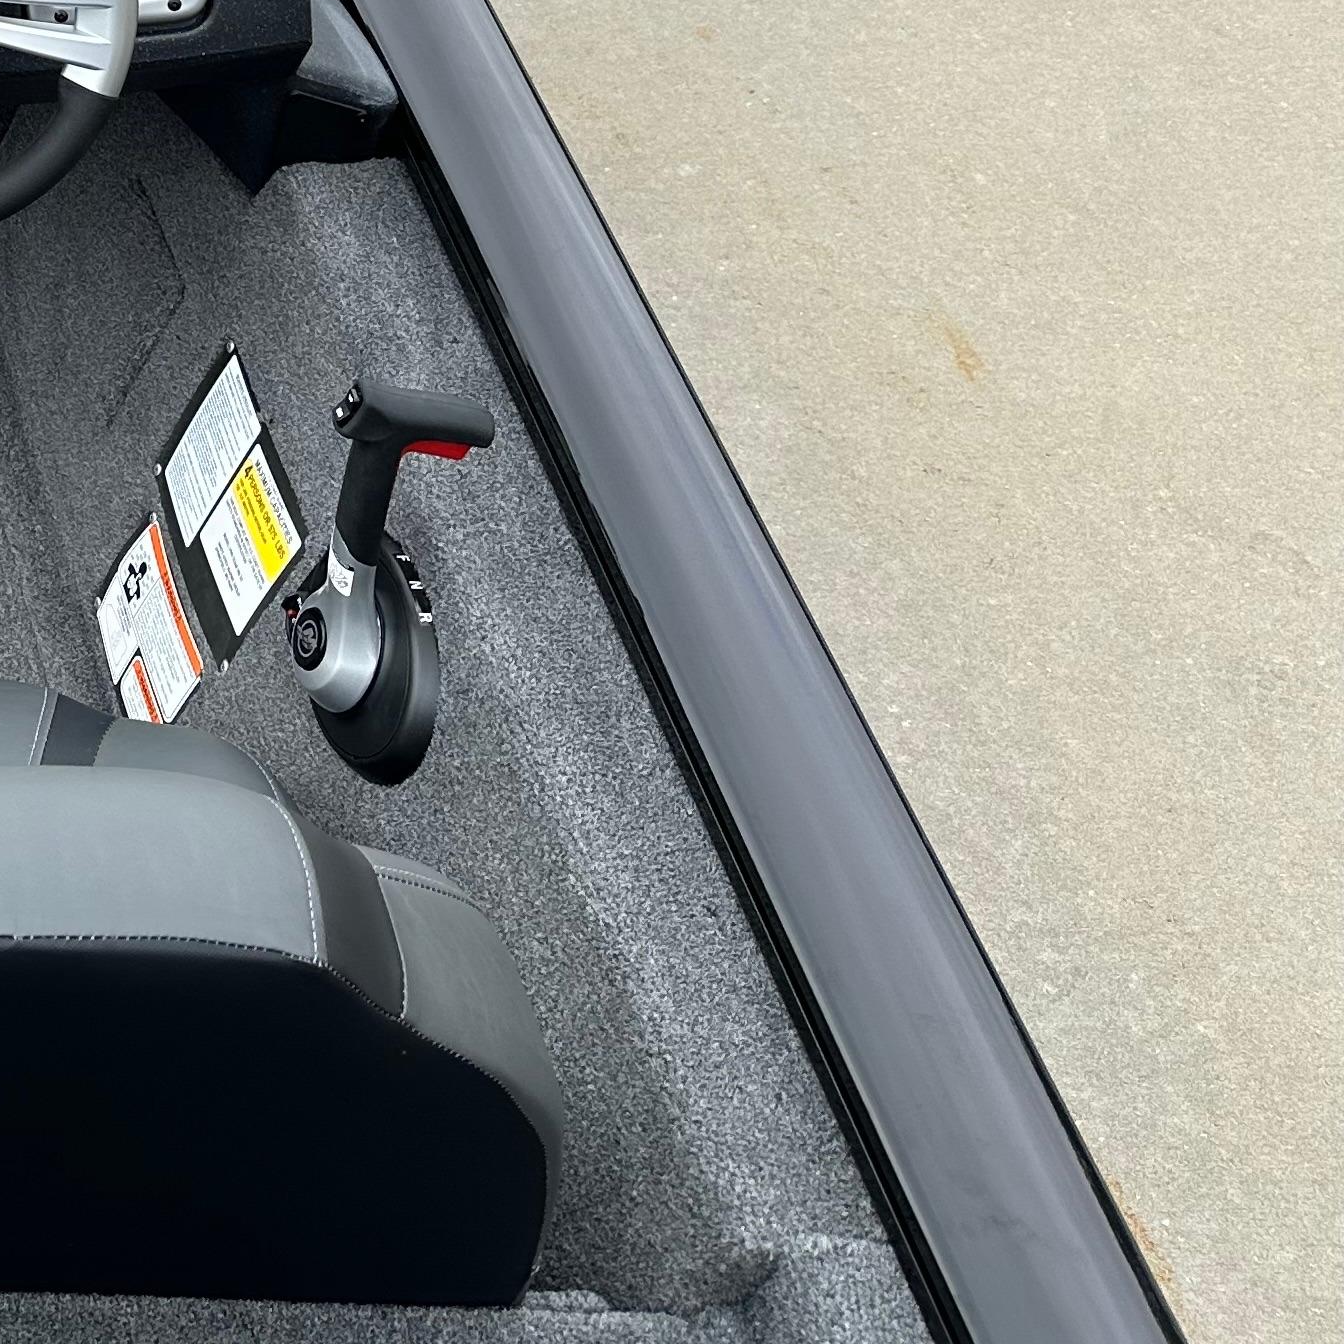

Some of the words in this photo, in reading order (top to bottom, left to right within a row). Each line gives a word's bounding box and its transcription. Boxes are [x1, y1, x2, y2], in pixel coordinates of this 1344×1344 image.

[247, 474, 266, 513] PERSONS
[263, 511, 272, 526] OR
[274, 539, 285, 559] LBS
[396, 554, 411, 562] F
[409, 580, 424, 590] N
[418, 612, 433, 623] R
